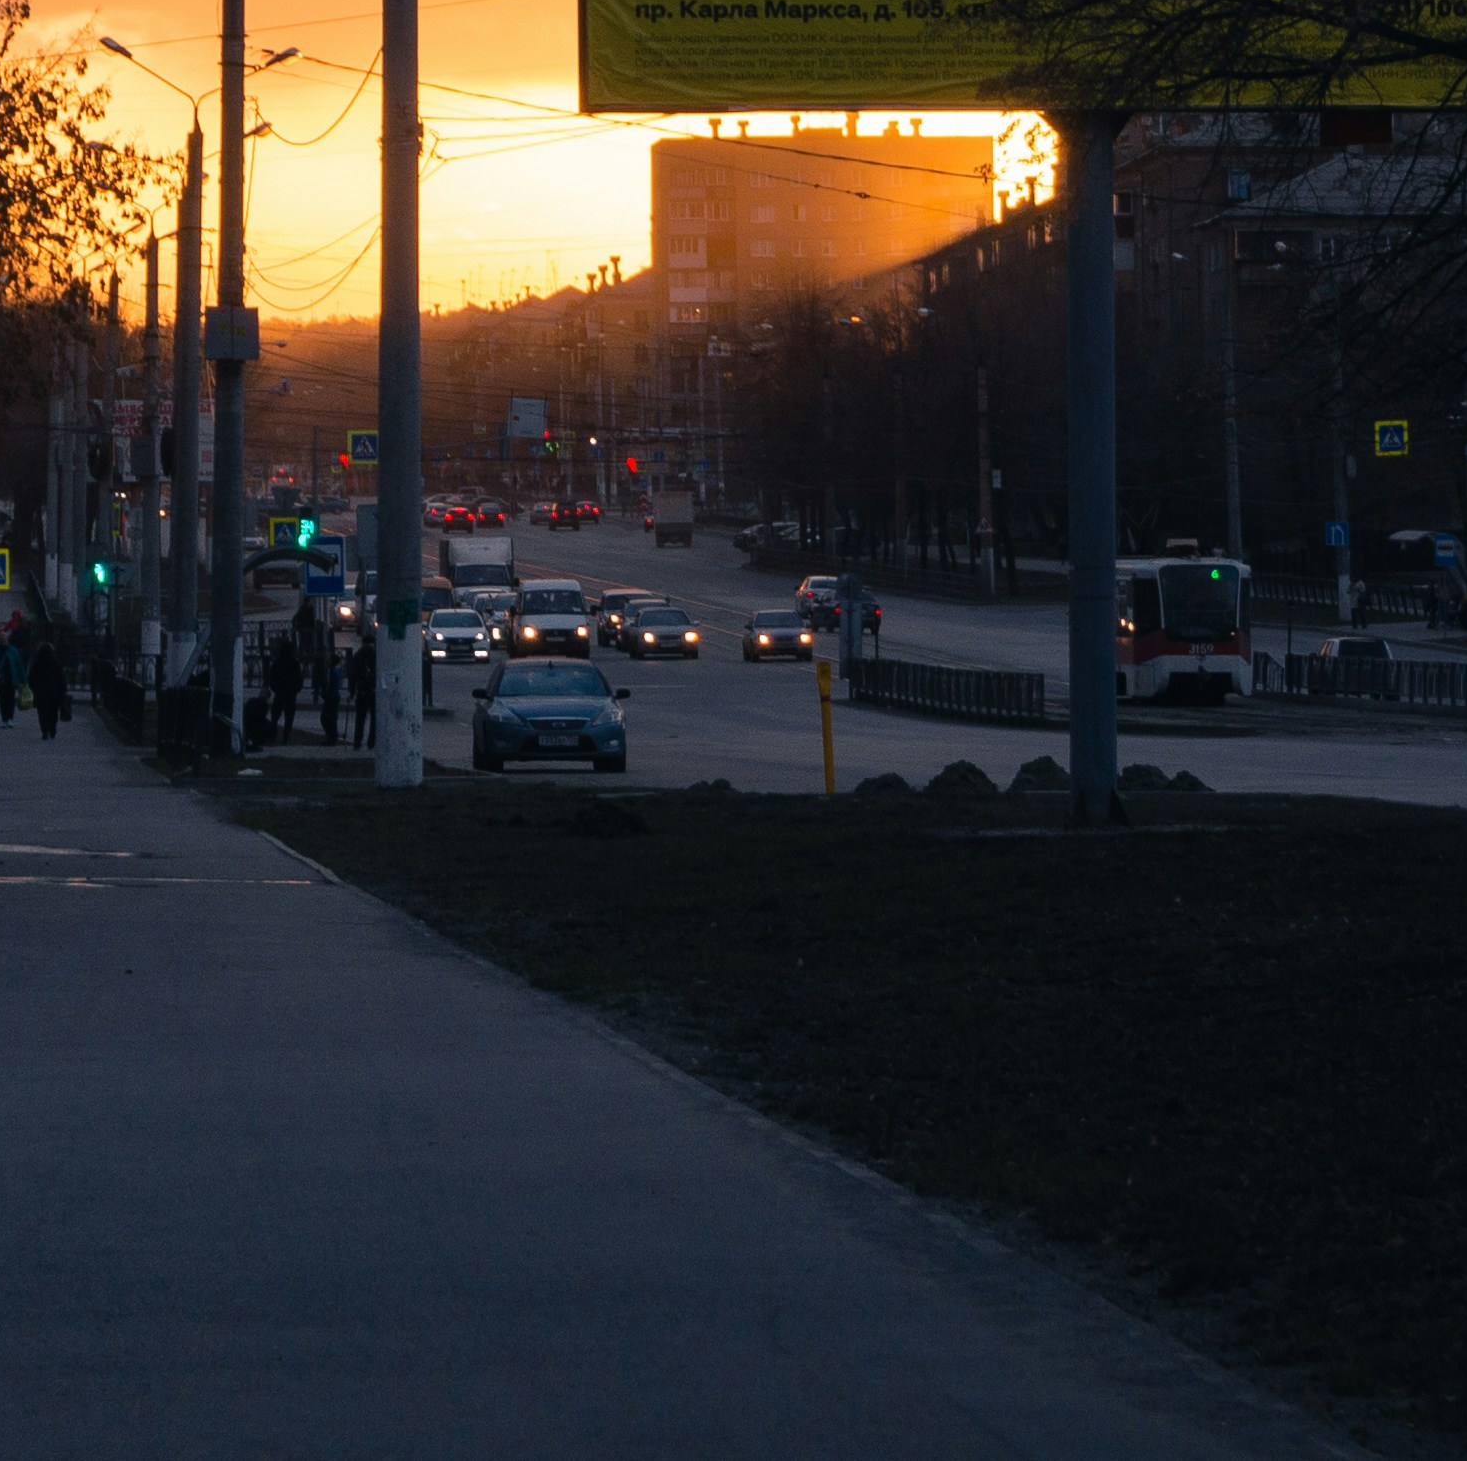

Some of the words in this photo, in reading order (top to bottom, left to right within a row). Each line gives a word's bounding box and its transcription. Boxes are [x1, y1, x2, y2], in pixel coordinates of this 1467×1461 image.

[635, 3, 674, 23] пр.
[679, 0, 759, 23] Карла
[764, 0, 869, 23] Маркса,
[873, 3, 897, 21] д.
[1210, 568, 1220, 580] 6
